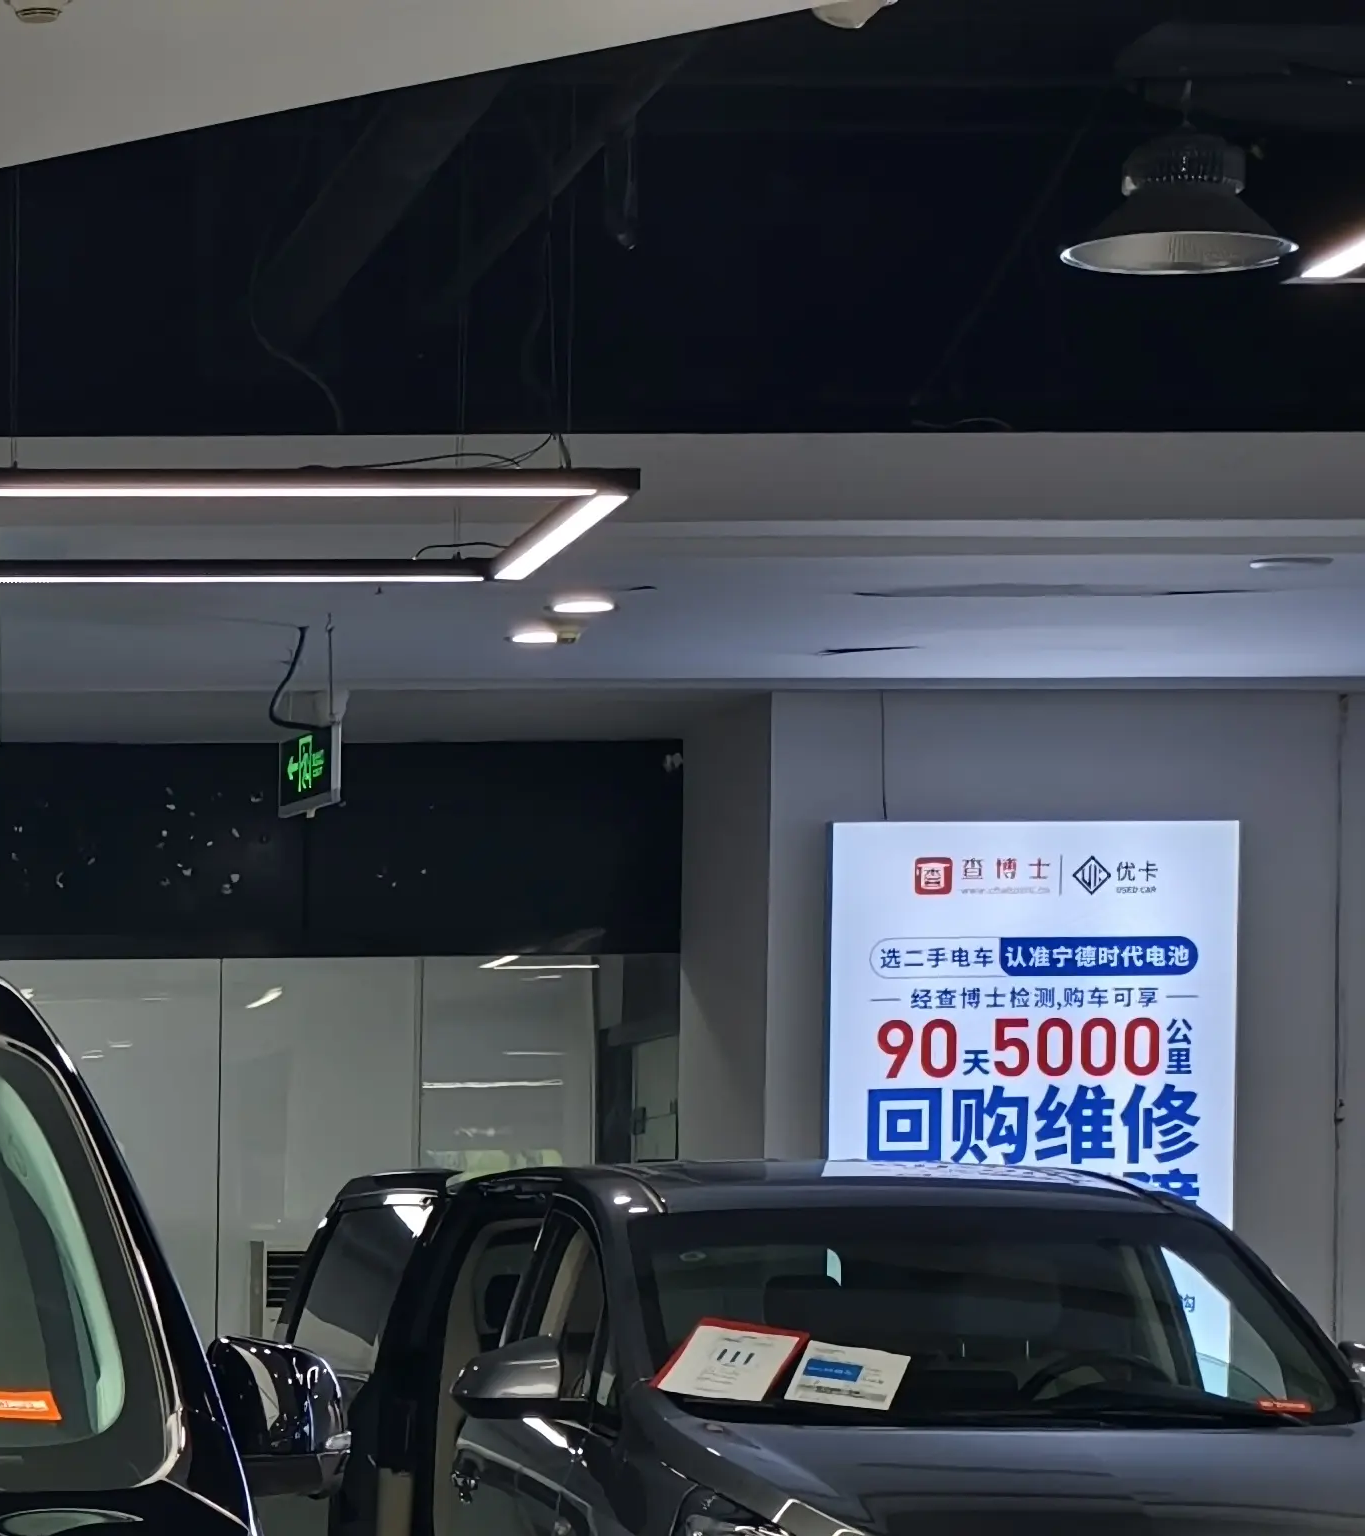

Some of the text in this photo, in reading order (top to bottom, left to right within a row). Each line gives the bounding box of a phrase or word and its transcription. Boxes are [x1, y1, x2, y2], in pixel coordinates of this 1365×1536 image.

[961, 857, 1051, 880] 查博士
[1116, 859, 1159, 882] 优卡
[880, 945, 1191, 969] 选二手电车 认准宁德时代电池
[867, 1084, 1201, 1165] 回购维修
